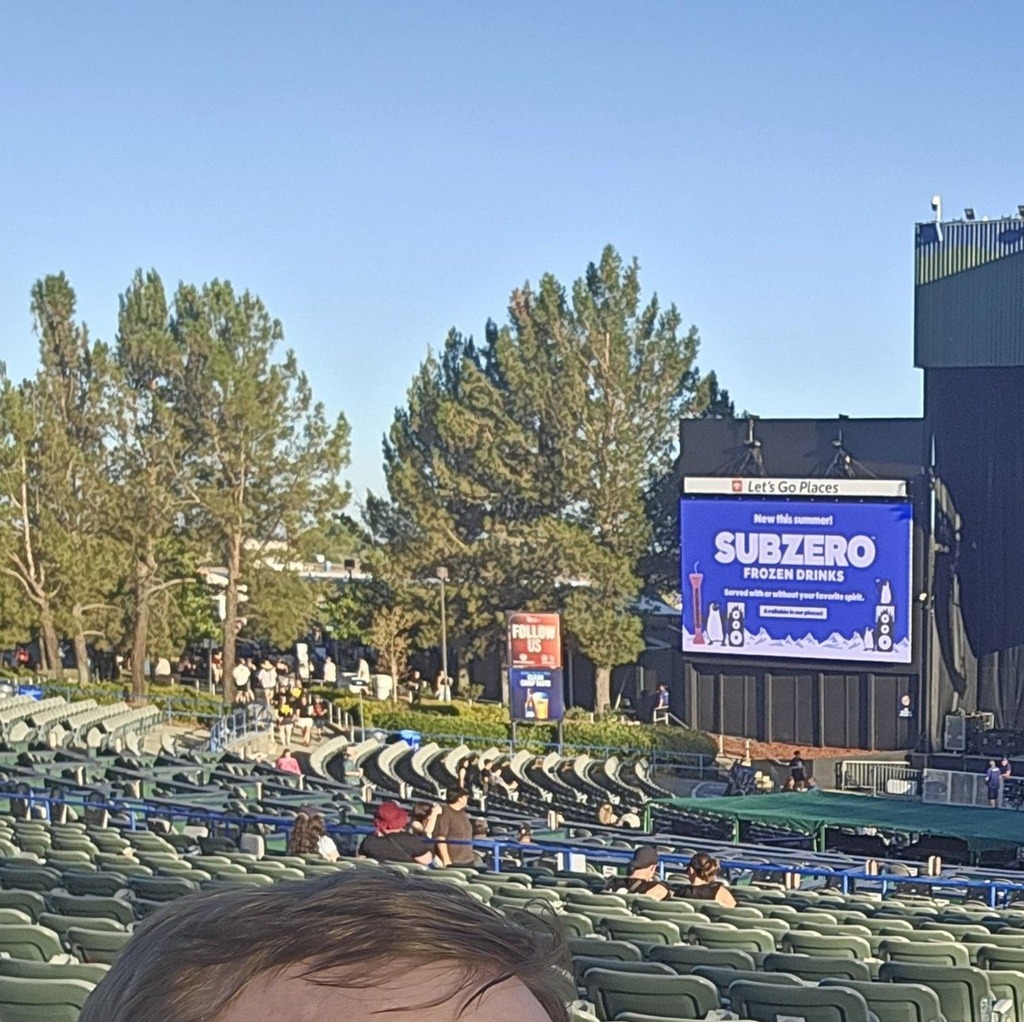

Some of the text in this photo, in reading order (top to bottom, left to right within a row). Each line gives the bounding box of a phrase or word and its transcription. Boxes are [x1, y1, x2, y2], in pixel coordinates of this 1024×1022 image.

[748, 480, 839, 494] Let's Go Places
[776, 513, 793, 525] this
[793, 515, 834, 526] summer!
[714, 531, 876, 568] SUBZERO
[743, 567, 845, 582] FROZEN DRINKS
[724, 588, 749, 597] Served
[749, 589, 765, 598] with
[772, 590, 799, 599] without
[799, 591, 815, 601] your
[815, 591, 844, 601] favorite
[844, 592, 865, 603] spirit.
[512, 624, 556, 640] FOLLOW
[527, 639, 542, 653] US
